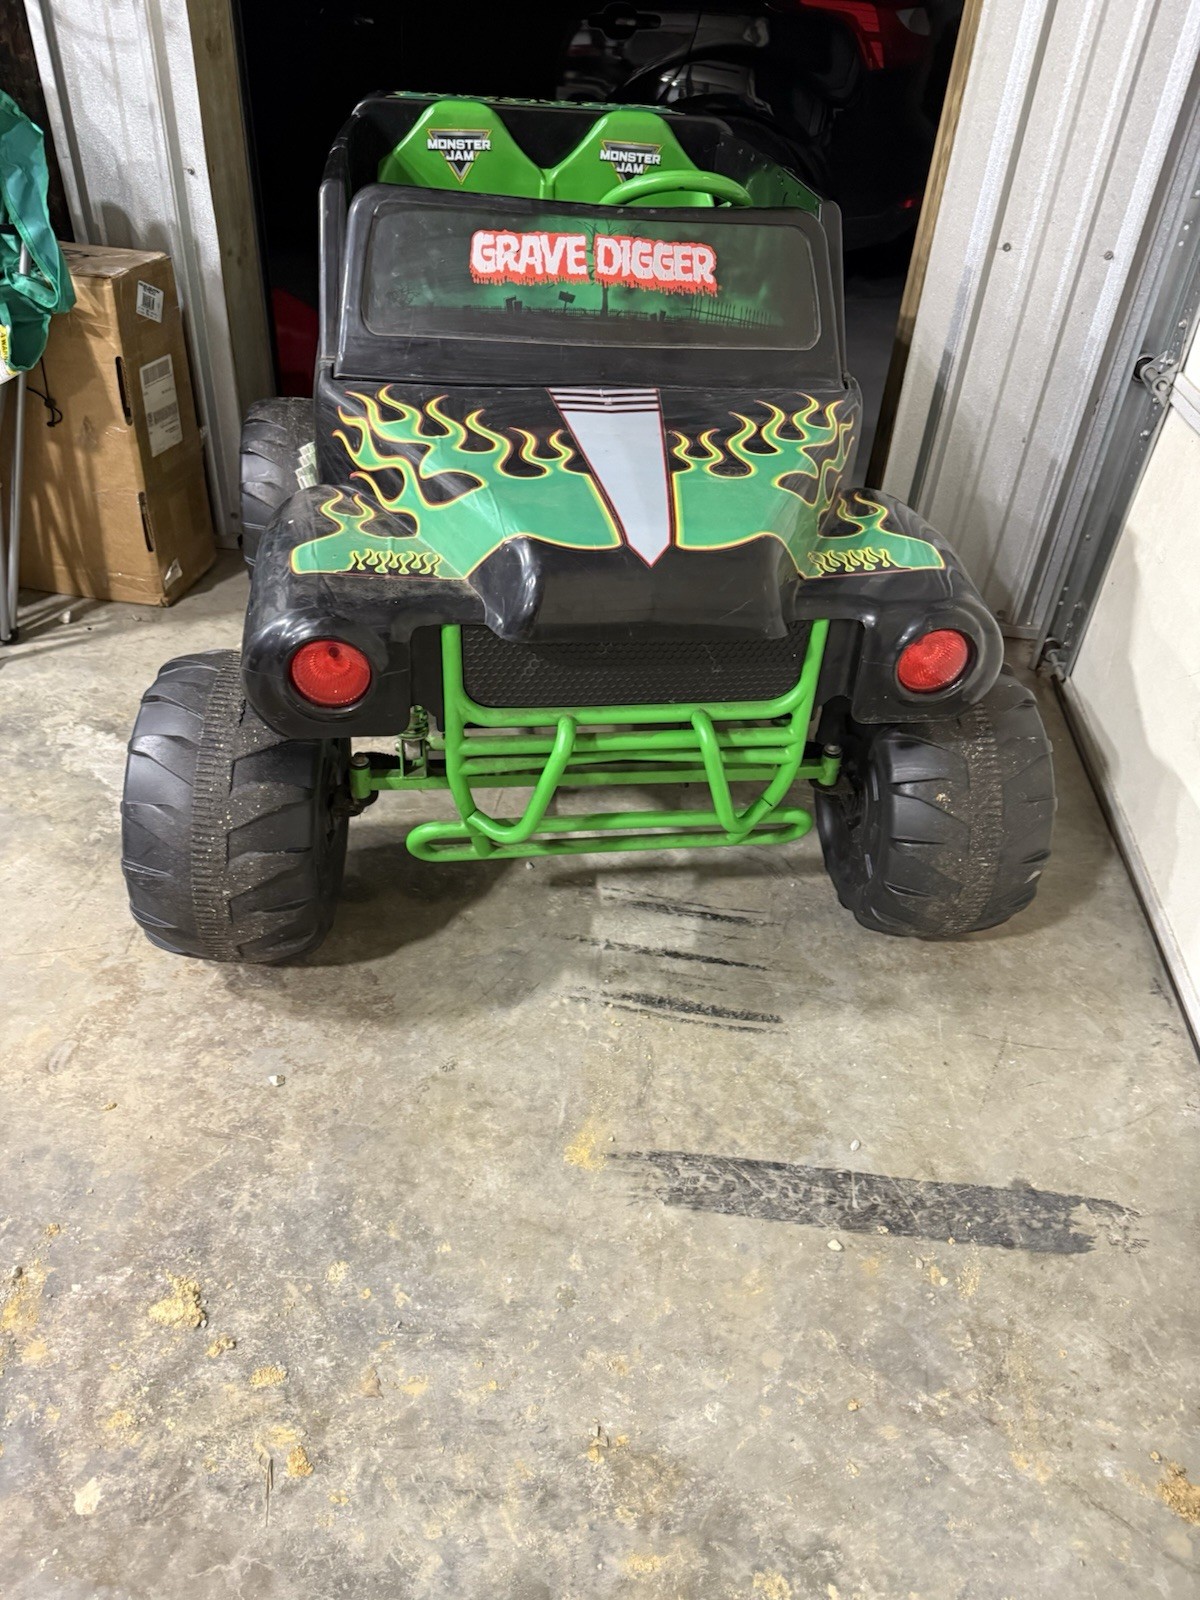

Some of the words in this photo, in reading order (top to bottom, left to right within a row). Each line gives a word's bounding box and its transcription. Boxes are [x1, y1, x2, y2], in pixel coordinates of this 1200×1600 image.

[427, 138, 491, 151] MONSTER
[446, 150, 475, 162] JAM
[600, 150, 661, 165] MONSTER
[616, 162, 644, 175] JAM
[470, 231, 588, 277] GRAVE
[595, 235, 717, 286] DIGGER
